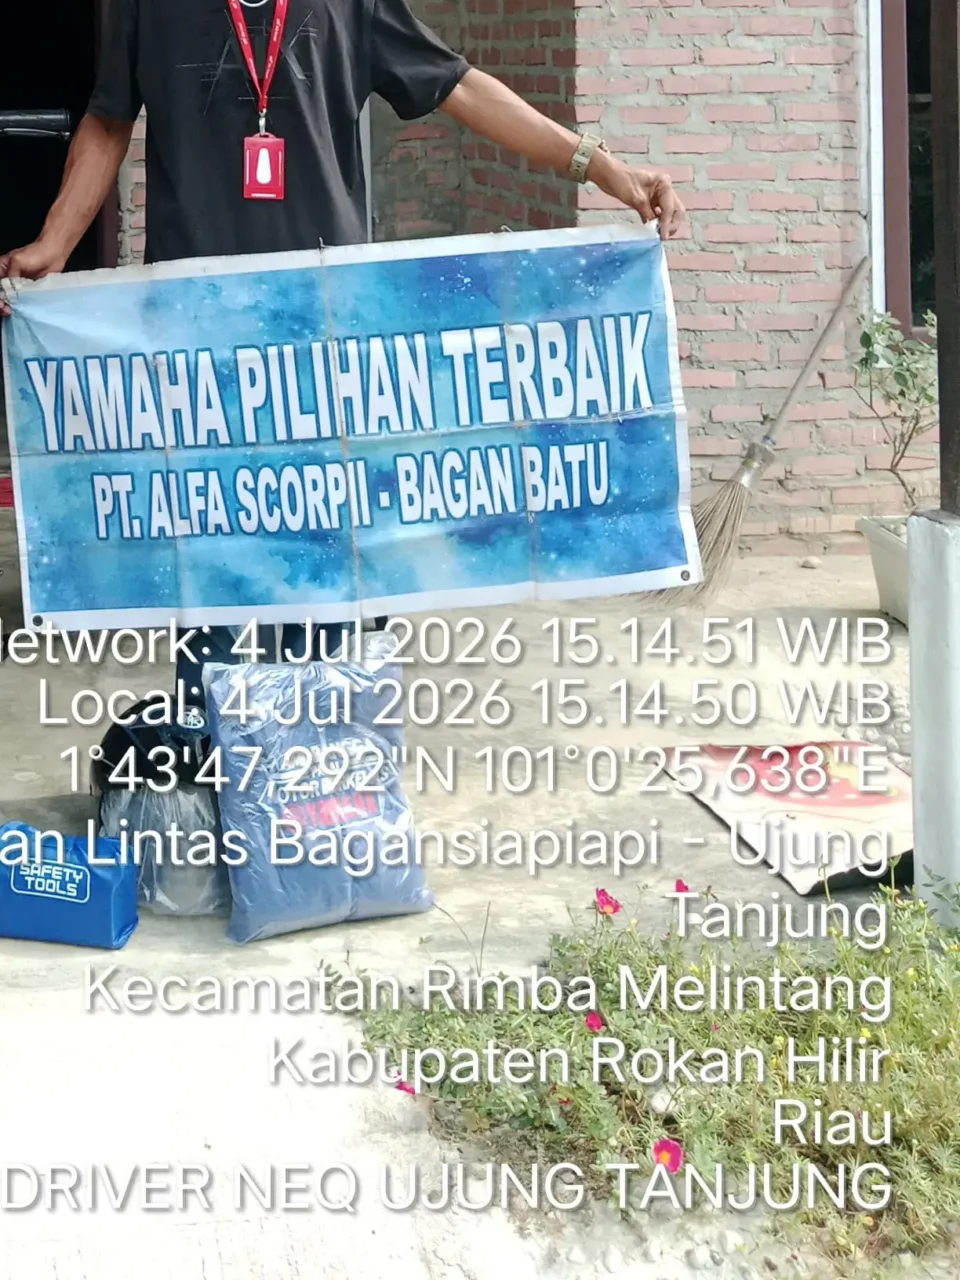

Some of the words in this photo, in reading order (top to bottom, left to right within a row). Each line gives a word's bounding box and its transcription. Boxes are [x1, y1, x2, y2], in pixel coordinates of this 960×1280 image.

[25, 349, 231, 453] YAMAHA
[234, 332, 431, 444] PILIHAN
[441, 312, 653, 426] TERBAIK
[91, 473, 143, 540] PT.
[148, 469, 231, 536] ALFA
[237, 459, 373, 534] SCORPII
[399, 446, 514, 523] BAGAN
[522, 441, 610, 513] BATU
[20, 863, 83, 883] SAFETY
[25, 876, 77, 897] TOOLS
